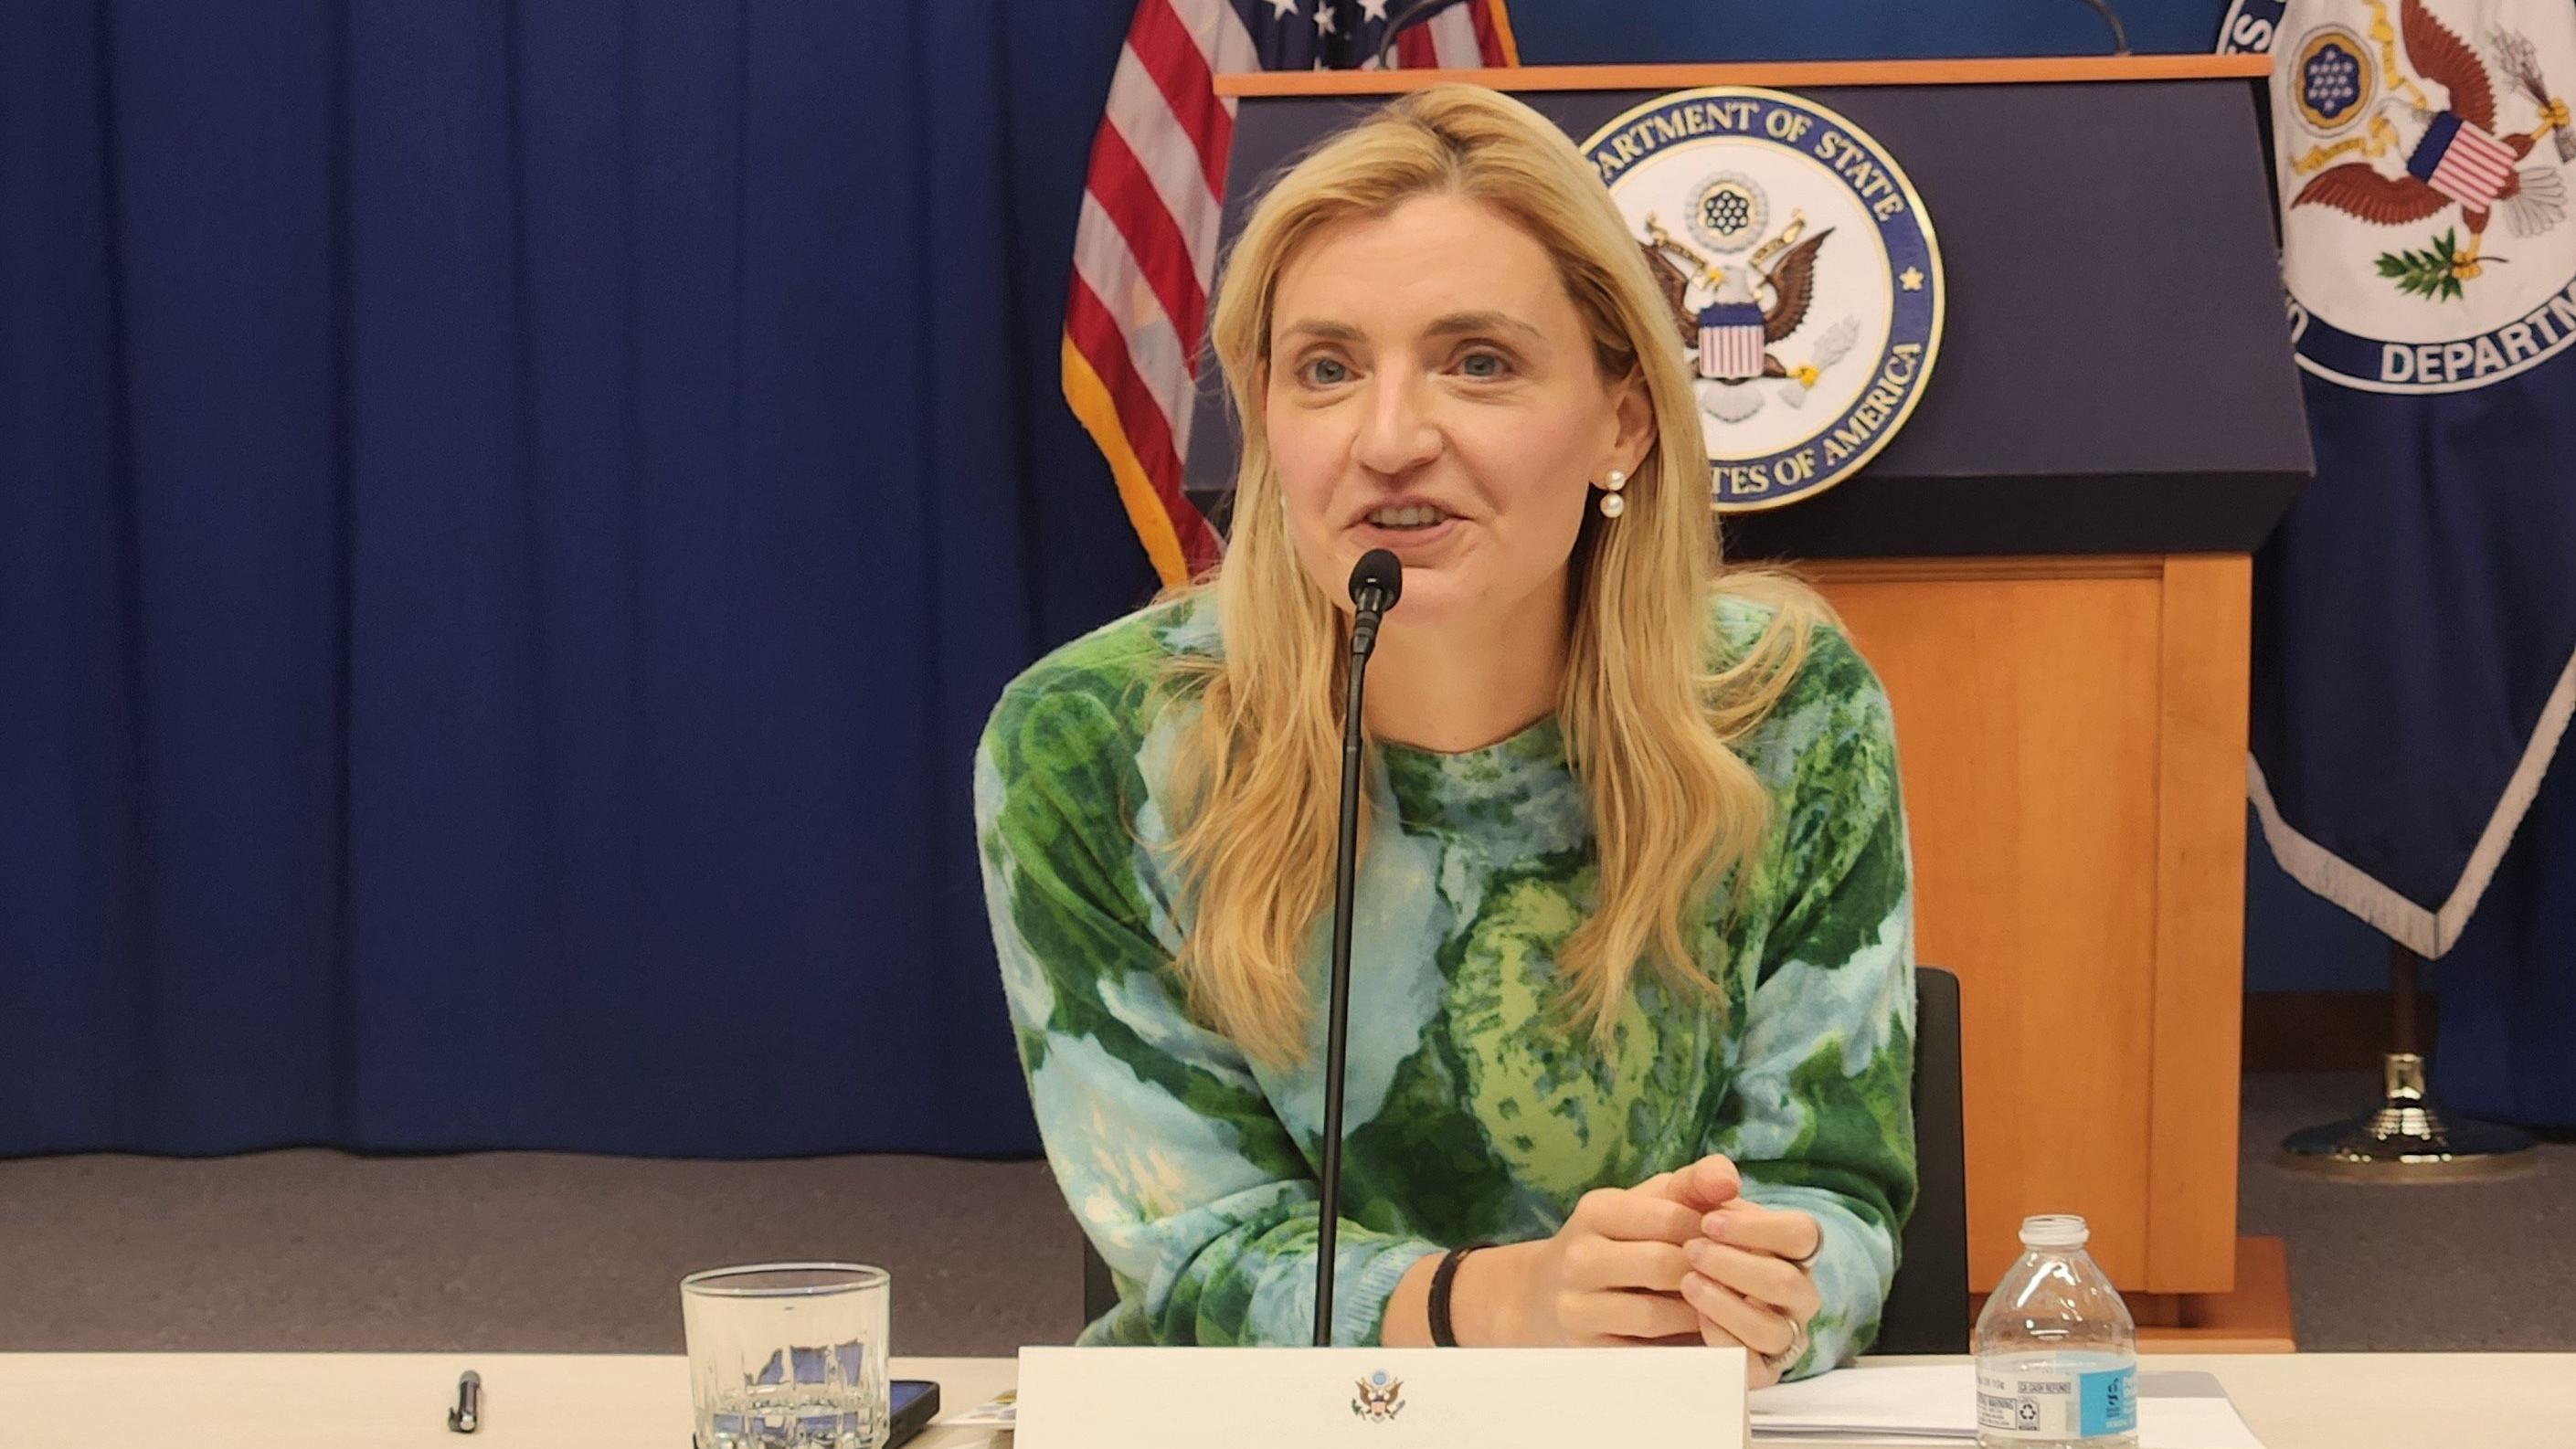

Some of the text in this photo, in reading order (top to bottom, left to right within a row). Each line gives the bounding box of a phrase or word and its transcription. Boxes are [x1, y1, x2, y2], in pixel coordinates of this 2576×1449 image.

[1596, 101, 1905, 222] ARTMENT OF STATE
[2380, 279, 2576, 384] DEPARTM
[1711, 344, 1923, 495] TES OF AMERICA
